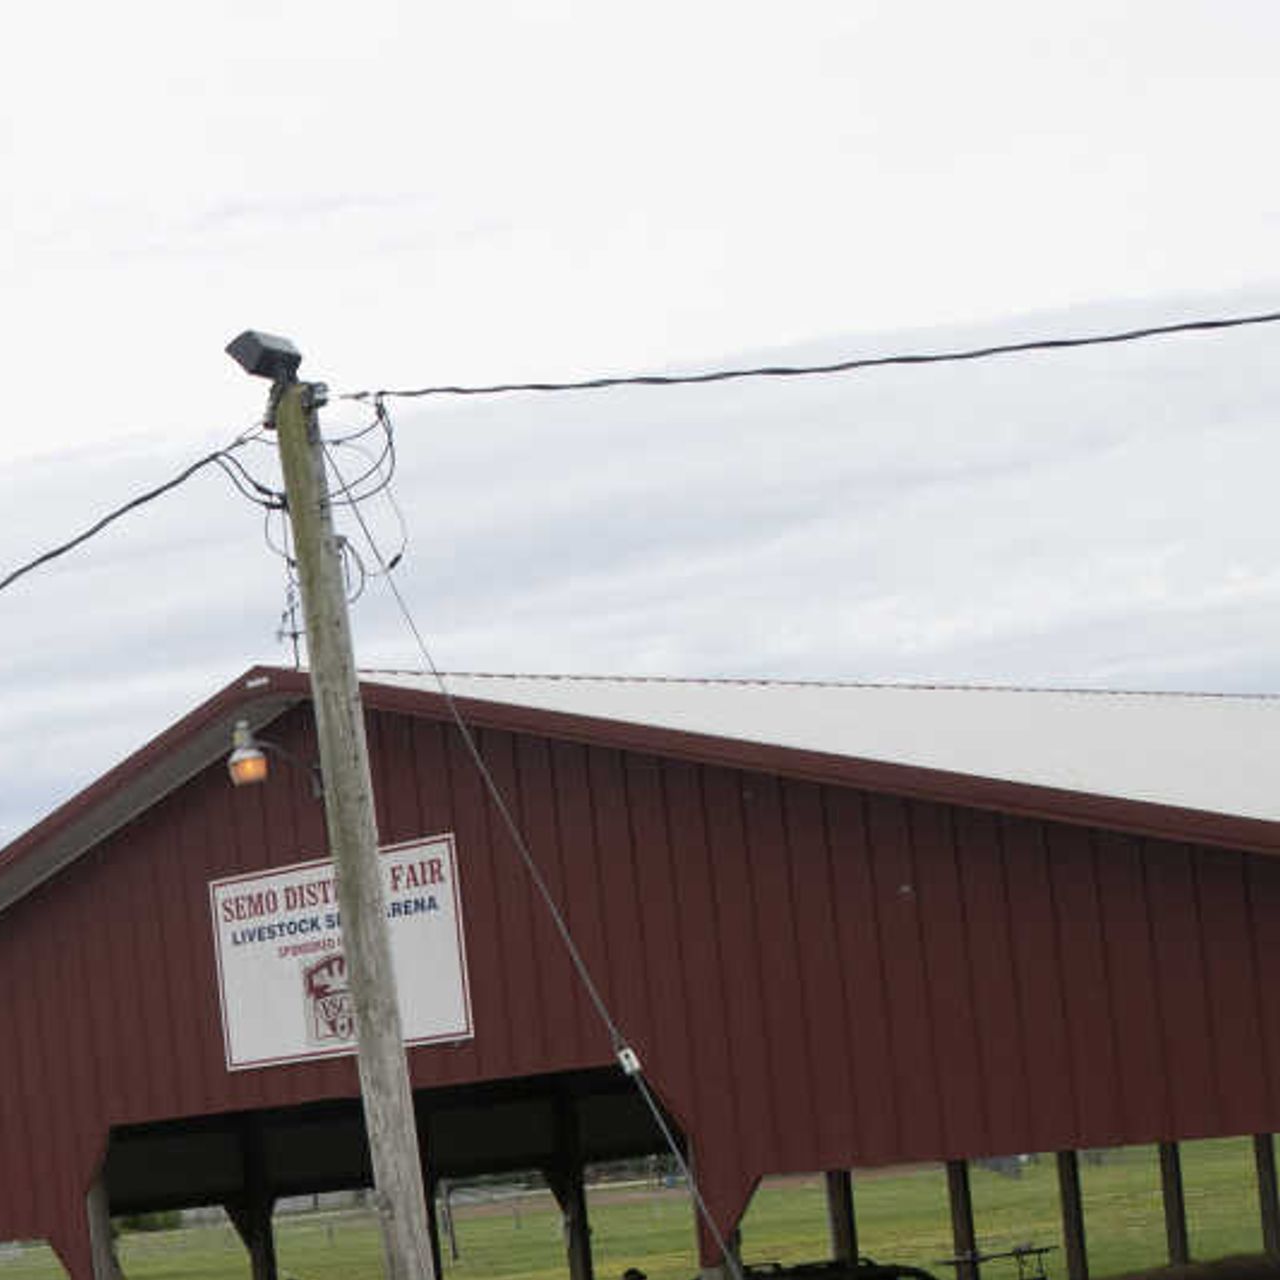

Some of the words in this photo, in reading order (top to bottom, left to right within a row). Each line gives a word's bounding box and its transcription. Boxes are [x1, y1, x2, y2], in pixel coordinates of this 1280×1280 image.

[221, 887, 279, 923] SEMO
[390, 856, 445, 892] FAIR
[232, 916, 321, 945] LIVESTOCK
[386, 895, 438, 918] RENA
